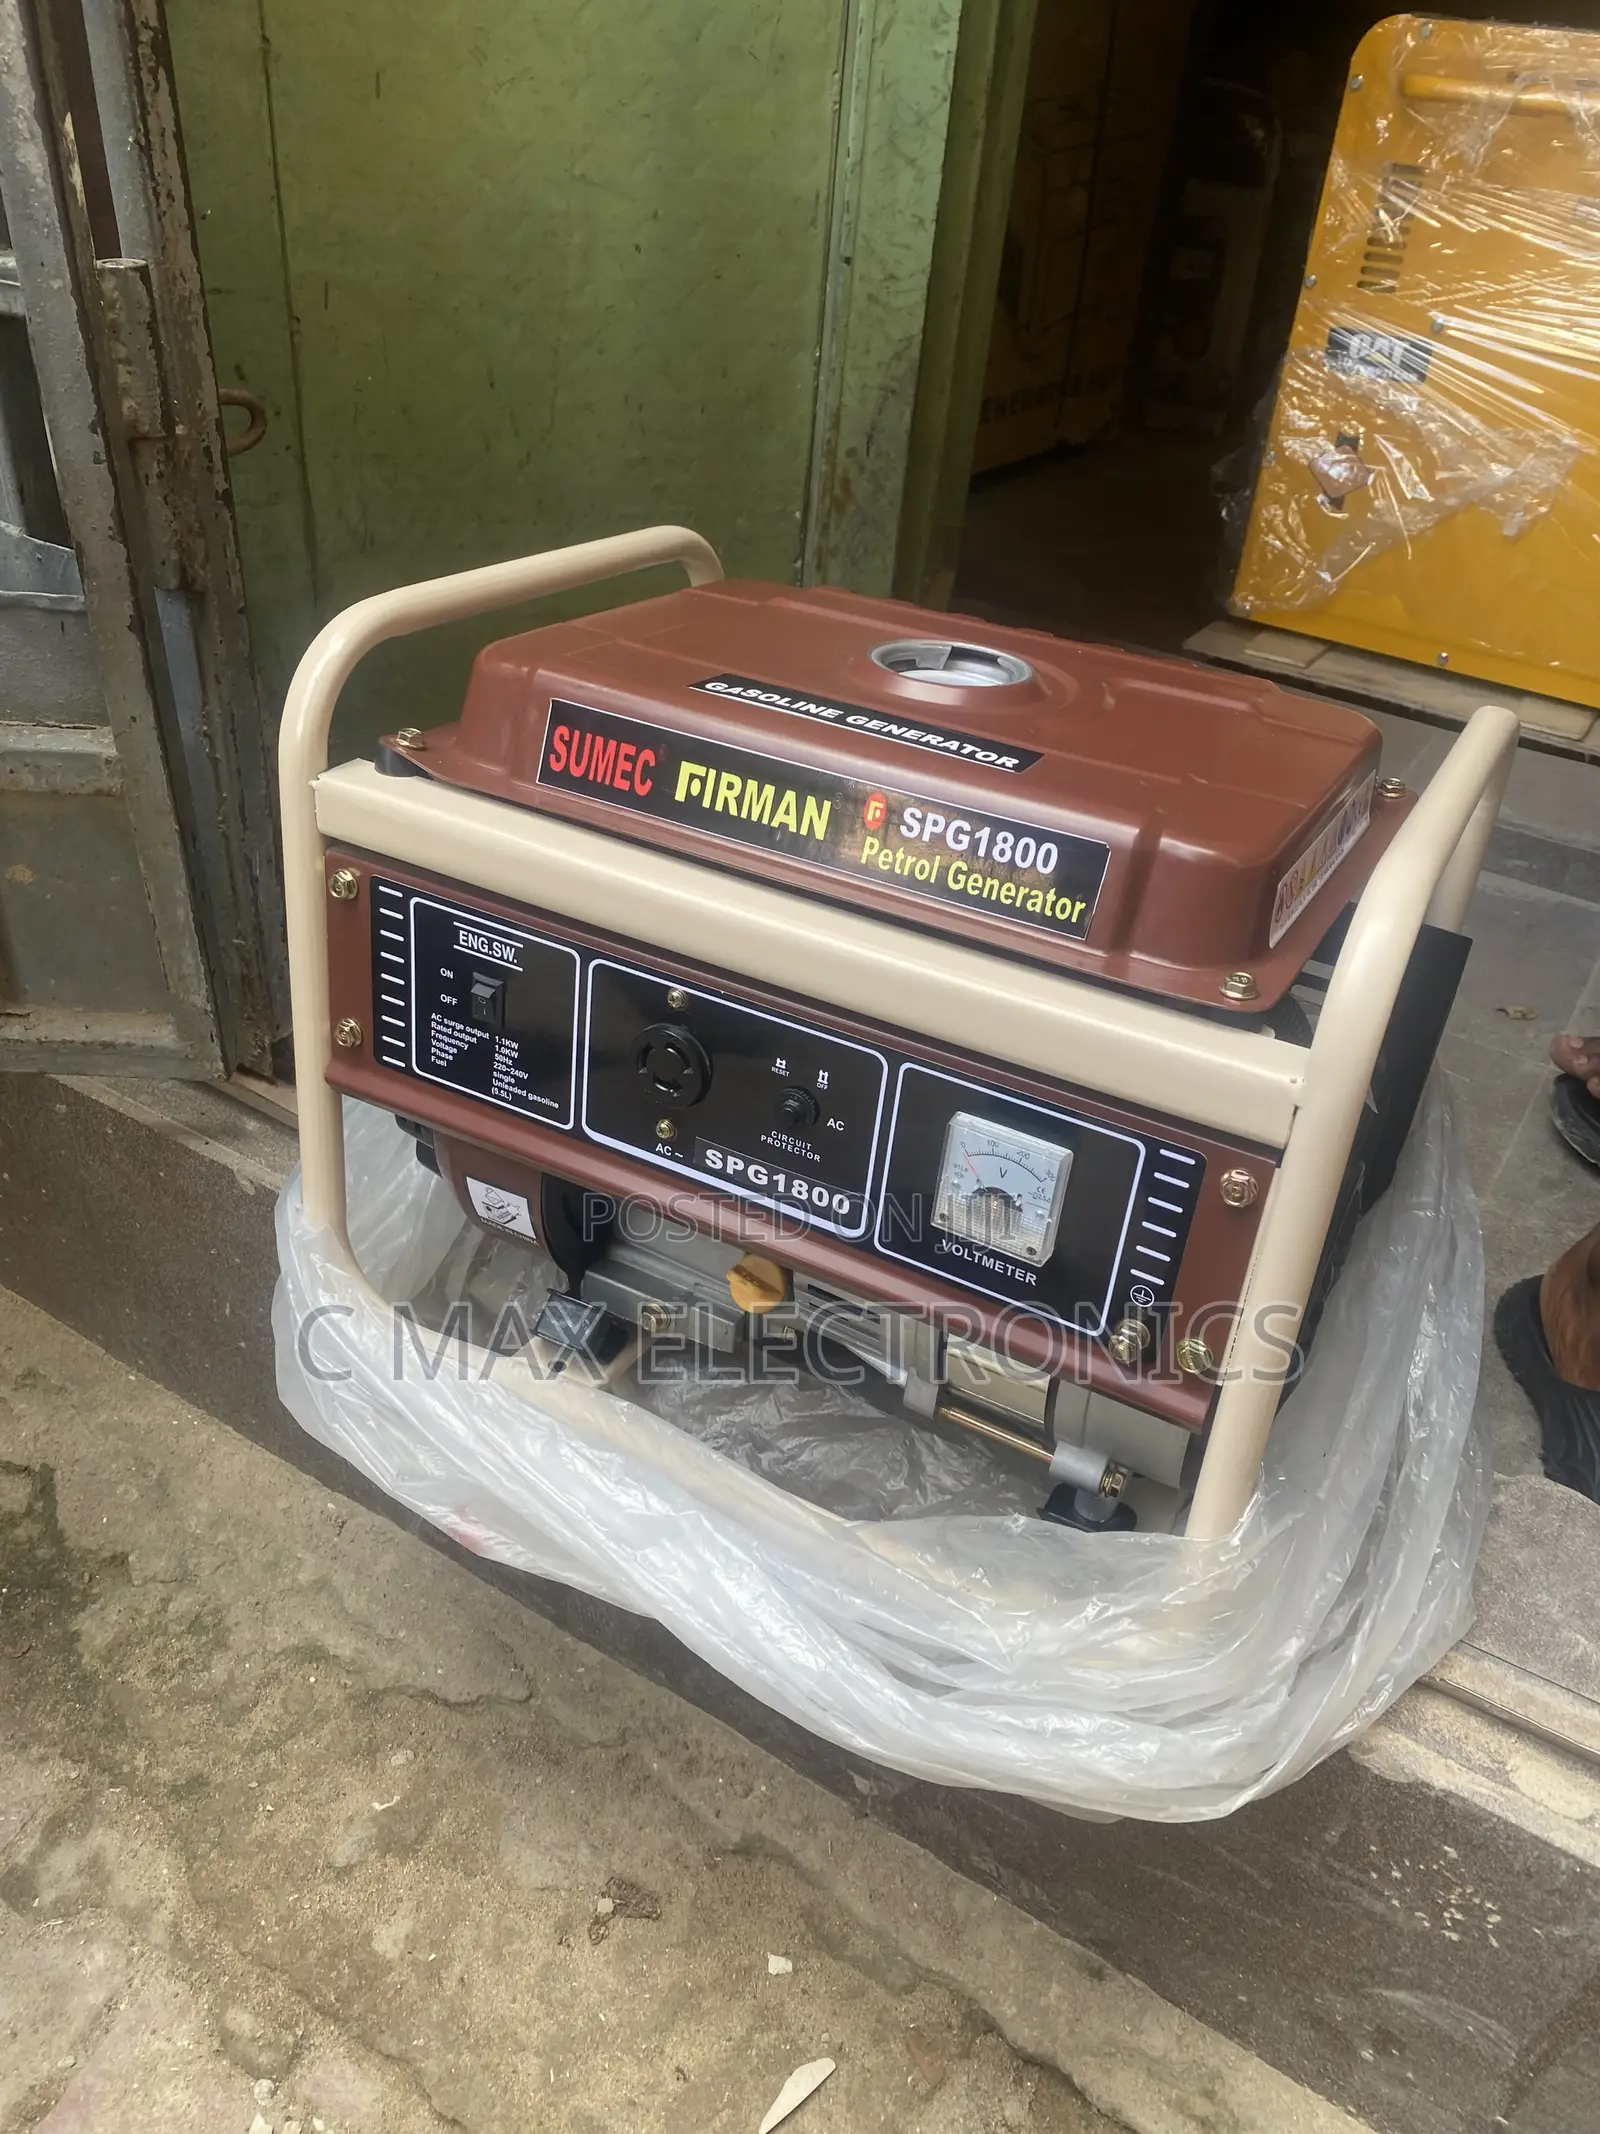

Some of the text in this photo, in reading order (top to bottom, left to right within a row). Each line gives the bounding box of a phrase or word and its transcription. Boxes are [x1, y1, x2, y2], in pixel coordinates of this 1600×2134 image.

[704, 681, 1020, 769] GASOLINE GENERATOR
[549, 725, 656, 796] SUMEC
[674, 760, 832, 841] FIRMAN
[900, 806, 1058, 875] SPG1800
[860, 836, 1087, 923] Petrol Generator
[459, 929, 517, 963] ENG.SW.
[440, 967, 453, 979] ON
[440, 993, 457, 1005] OFF
[431, 1012, 490, 1039] AC surge output
[431, 1021, 477, 1043] Rated output
[431, 1029, 468, 1050] Frequency
[431, 1038, 457, 1054] Voltage
[495, 1035, 518, 1049] 1.1KW
[431, 1046, 453, 1060] Phase
[494, 1044, 518, 1058] 1.0KW
[431, 1055, 447, 1066] Fuel
[494, 1053, 512, 1065] 50Hz
[493, 1070, 515, 1084] single
[771, 1066, 790, 1077] RESET
[492, 1078, 559, 1108] Unleaded gasoline
[816, 1081, 829, 1091] OFF
[826, 1117, 845, 1131] AC
[771, 1130, 812, 1150] CIRCUIT
[986, 1139, 999, 1149] 100
[760, 1134, 821, 1163] PROTECTOR
[1016, 1150, 1031, 1160] 200
[999, 1166, 1008, 1179] V
[705, 1148, 850, 1215] SPG1800
[941, 1238, 1037, 1287] VOLTMETER
